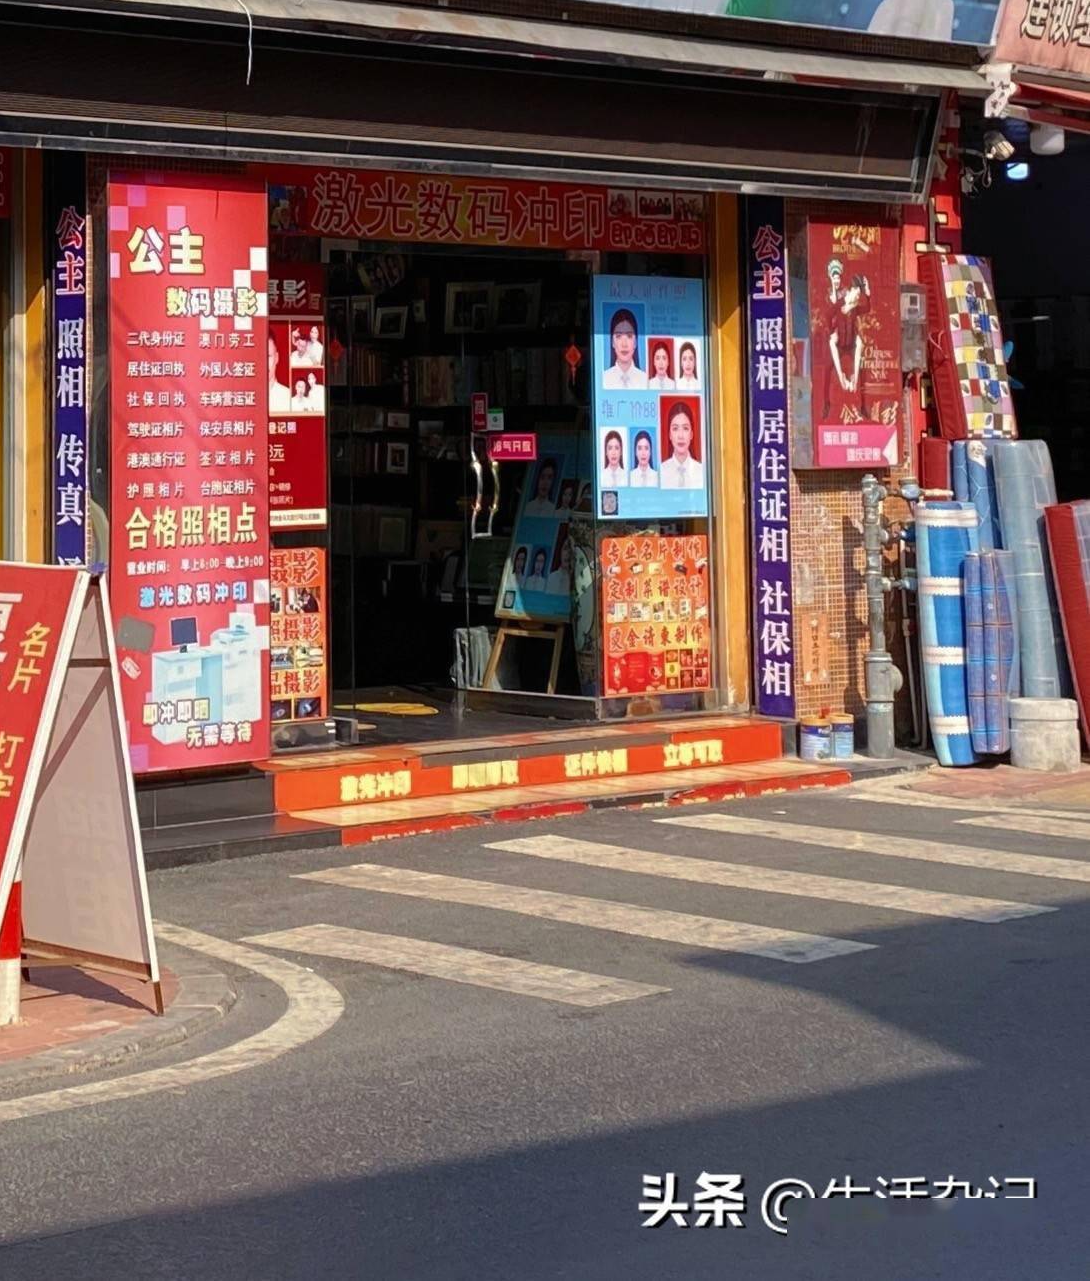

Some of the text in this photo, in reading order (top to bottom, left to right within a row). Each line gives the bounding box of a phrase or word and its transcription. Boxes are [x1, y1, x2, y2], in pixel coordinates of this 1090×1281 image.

[310, 171, 606, 248] 激光数码冲印
[55, 206, 85, 295] 公主
[126, 225, 206, 275] 公主
[166, 286, 259, 318] 数码摄影
[126, 331, 255, 349] 二代身份证 澳门劳工
[57, 318, 84, 408] 照相
[127, 361, 256, 378] 居住证回执 外国人签证
[127, 391, 186, 408] 社保回执
[127, 420, 255, 438] 驾驶证相片 保安员相片
[126, 449, 256, 469] 港澳通行证 签证相片
[752, 225, 792, 697] 公主 照相 居住证相 社保相
[56, 433, 84, 526] 传真
[126, 480, 186, 499] 护照相片
[200, 478, 256, 497] 台胞证相片
[125, 502, 258, 550] 合格照相点
[607, 536, 702, 563] 专业名片制作
[138, 580, 248, 609] 激光数码冲印
[607, 575, 703, 601] 定制菜谱设计
[7, 621, 52, 694] 名片
[185, 721, 253, 749] 无需等待
